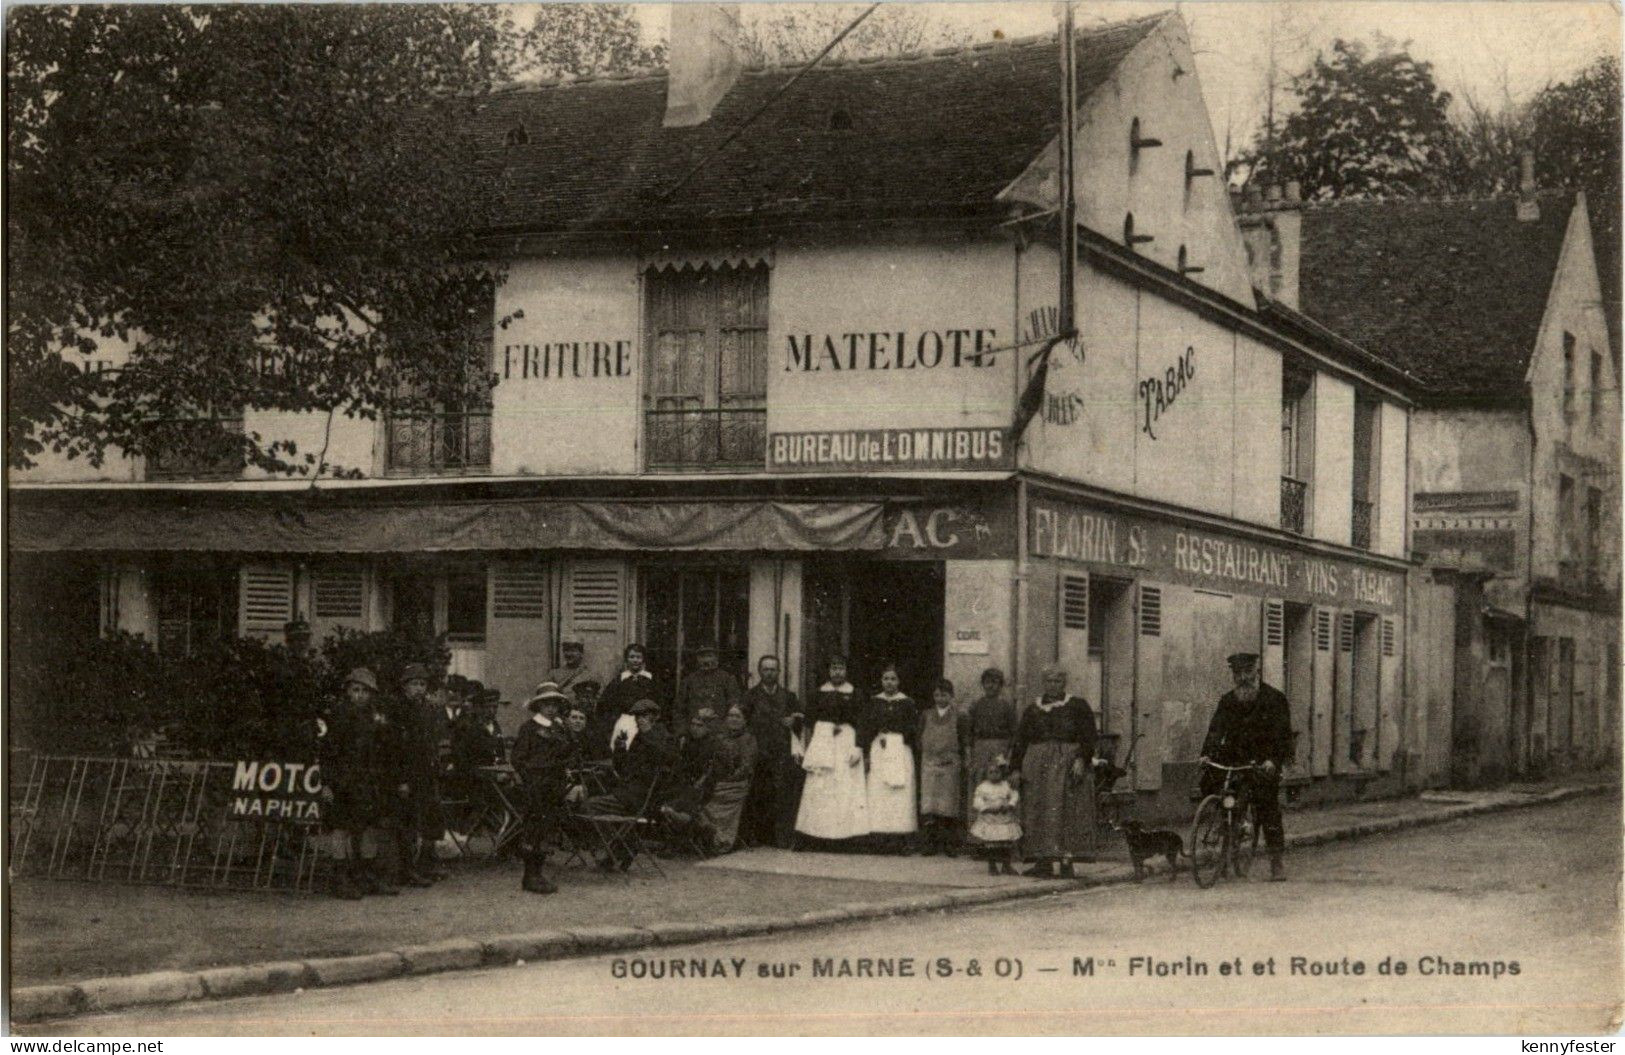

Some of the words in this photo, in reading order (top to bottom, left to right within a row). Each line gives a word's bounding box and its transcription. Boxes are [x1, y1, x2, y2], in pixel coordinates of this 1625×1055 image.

[504, 340, 632, 379] FRITURE
[784, 328, 997, 372] MATELOTE
[1139, 345, 1195, 441] TABAC
[773, 433, 856, 464] BUREAU
[858, 438, 880, 462] de
[1034, 508, 1117, 565] FLORIN
[1174, 532, 1291, 588] RESTAURANT
[1304, 559, 1339, 597] VINS
[1352, 567, 1394, 607] TABAC
[232, 797, 320, 819] NAPHTA
